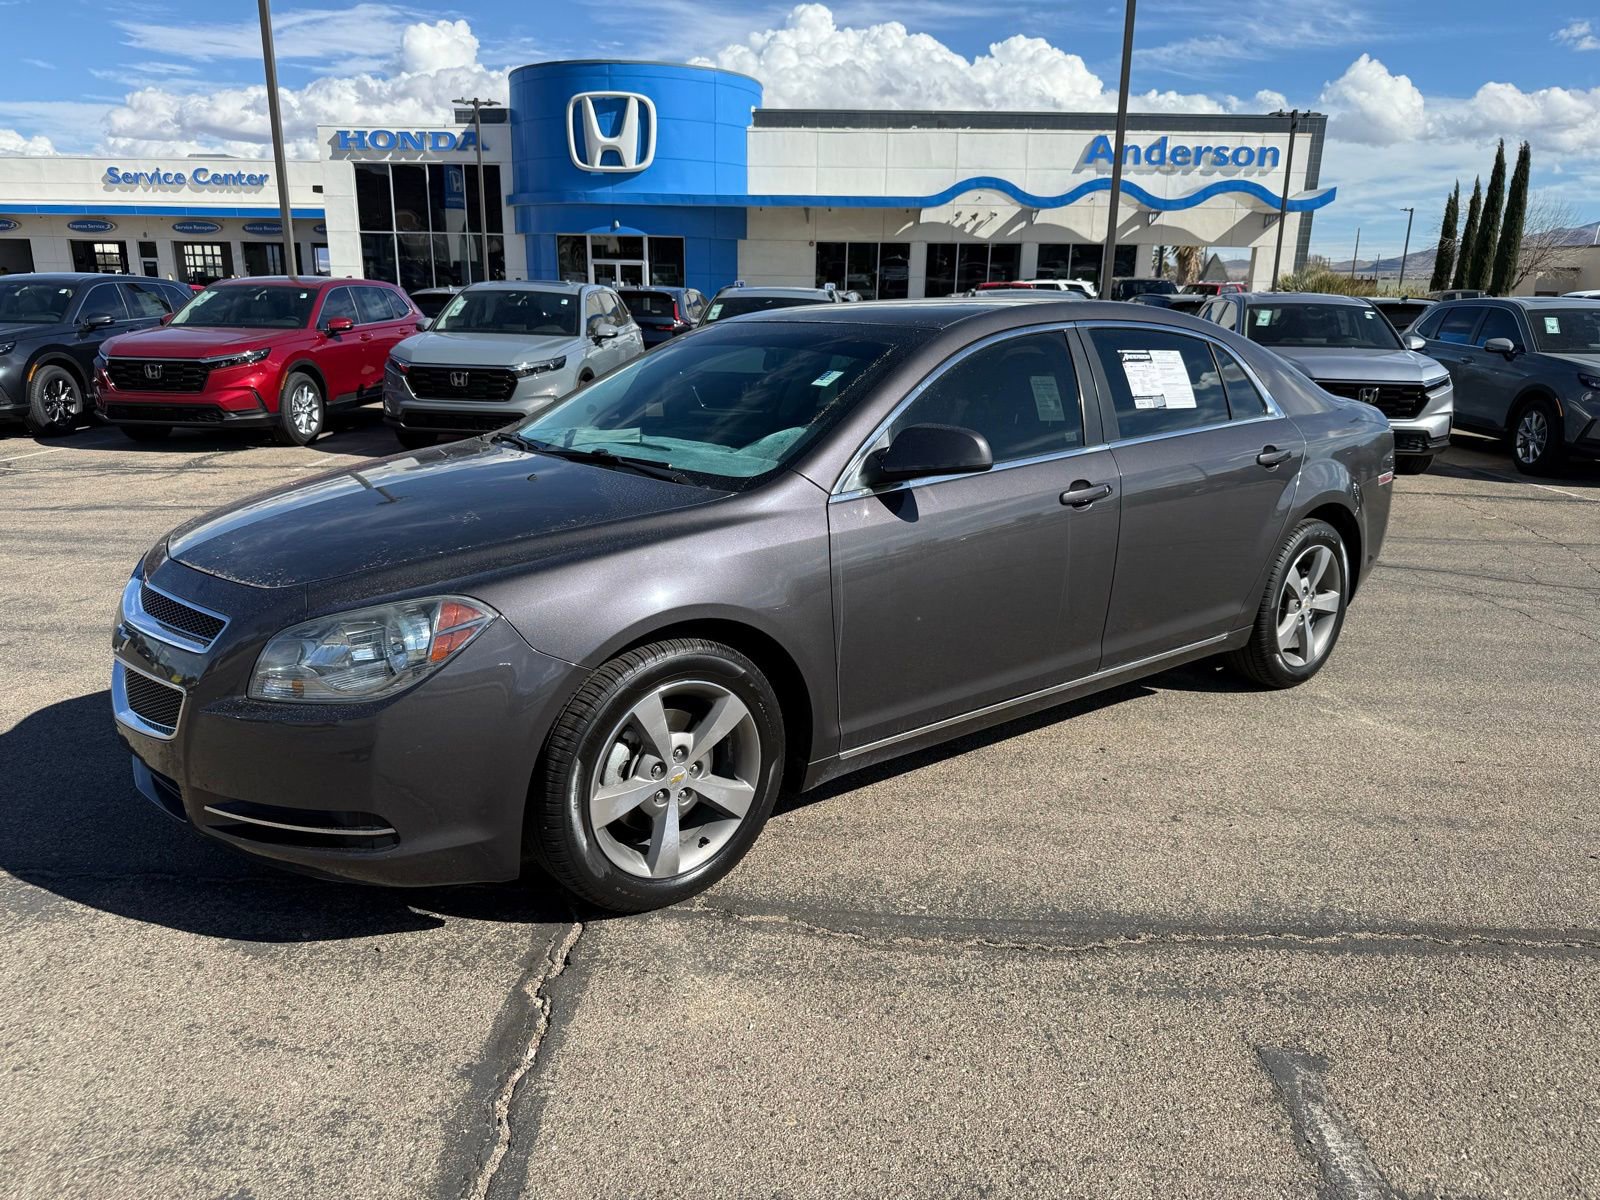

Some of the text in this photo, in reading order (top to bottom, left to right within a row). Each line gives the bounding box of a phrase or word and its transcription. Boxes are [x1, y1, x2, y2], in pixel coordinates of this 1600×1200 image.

[336, 130, 490, 151] HONDA
[1083, 135, 1280, 167] Anderson
[107, 167, 269, 185] Service Center
